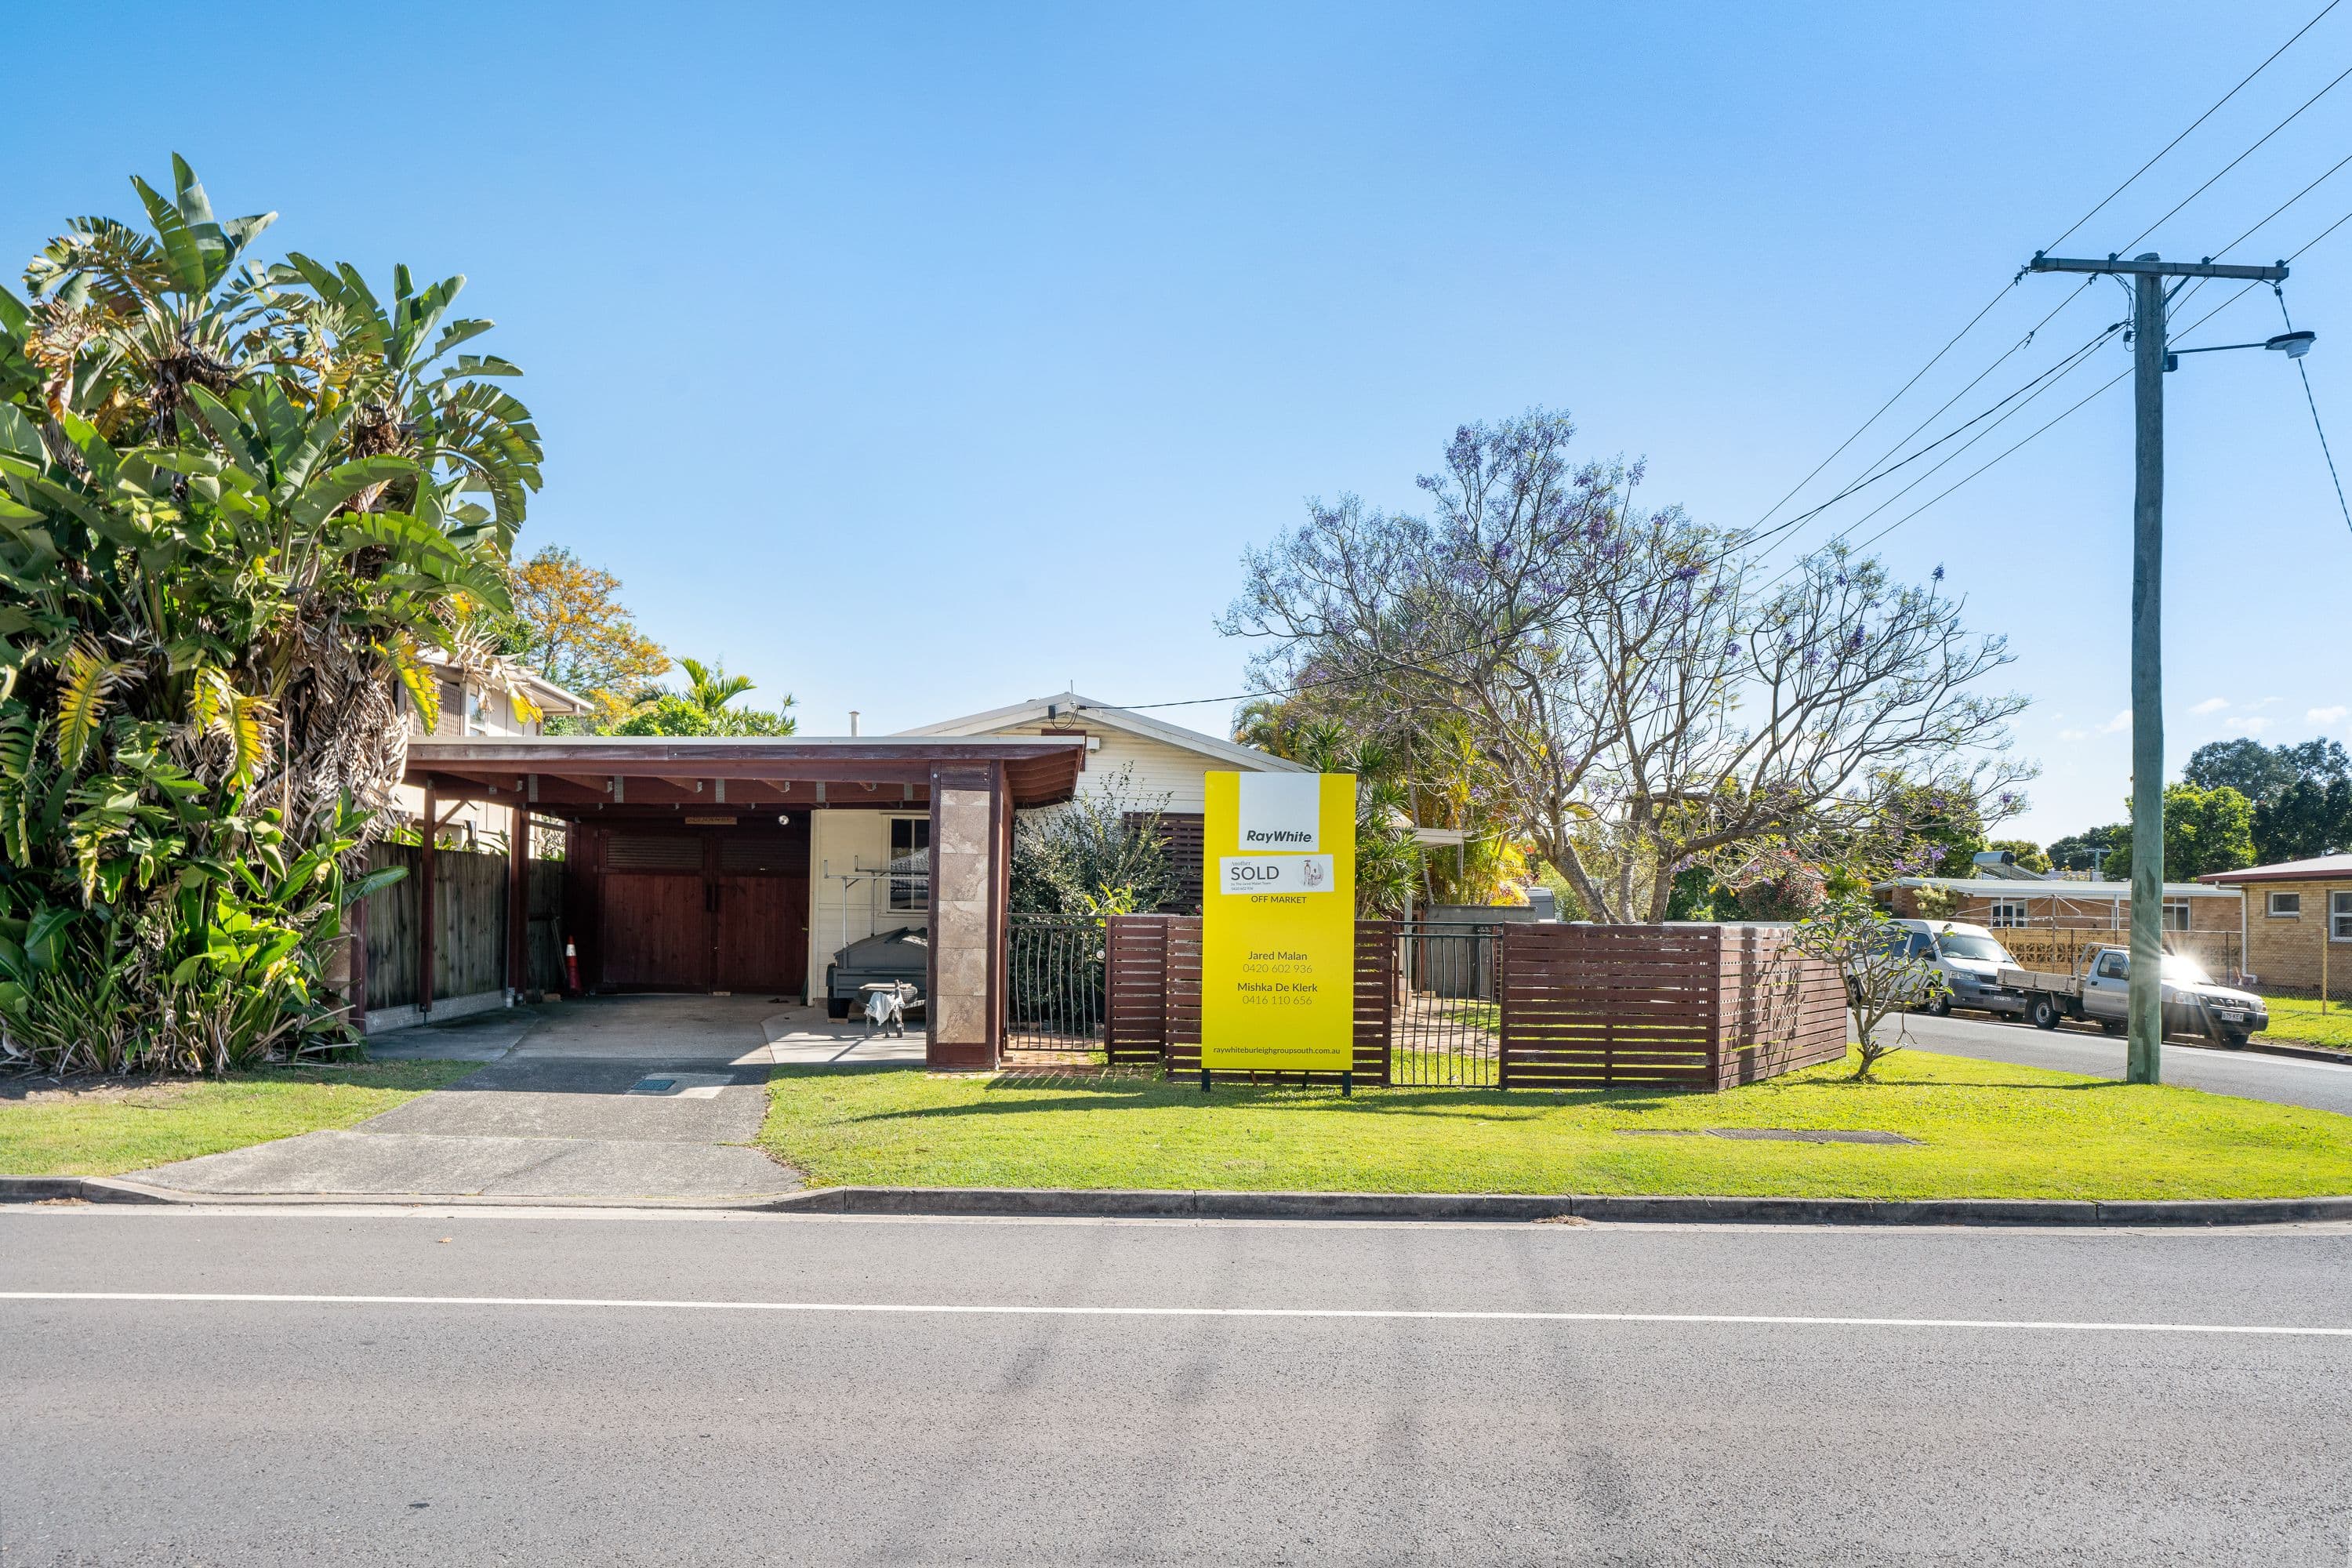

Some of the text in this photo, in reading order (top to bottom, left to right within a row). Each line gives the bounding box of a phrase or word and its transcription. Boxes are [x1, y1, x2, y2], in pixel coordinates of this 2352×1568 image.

[1231, 866, 1279, 881] SOLD
[1248, 951, 1308, 960] Jared Malan
[1243, 964, 1312, 974] 0420 602 936
[1237, 982, 1318, 993] Mishka De Klerk
[1243, 996, 1312, 1005] 0416 110 656
[1213, 1046, 1341, 1055] raywhiteburleighgroupsouth.com.au
